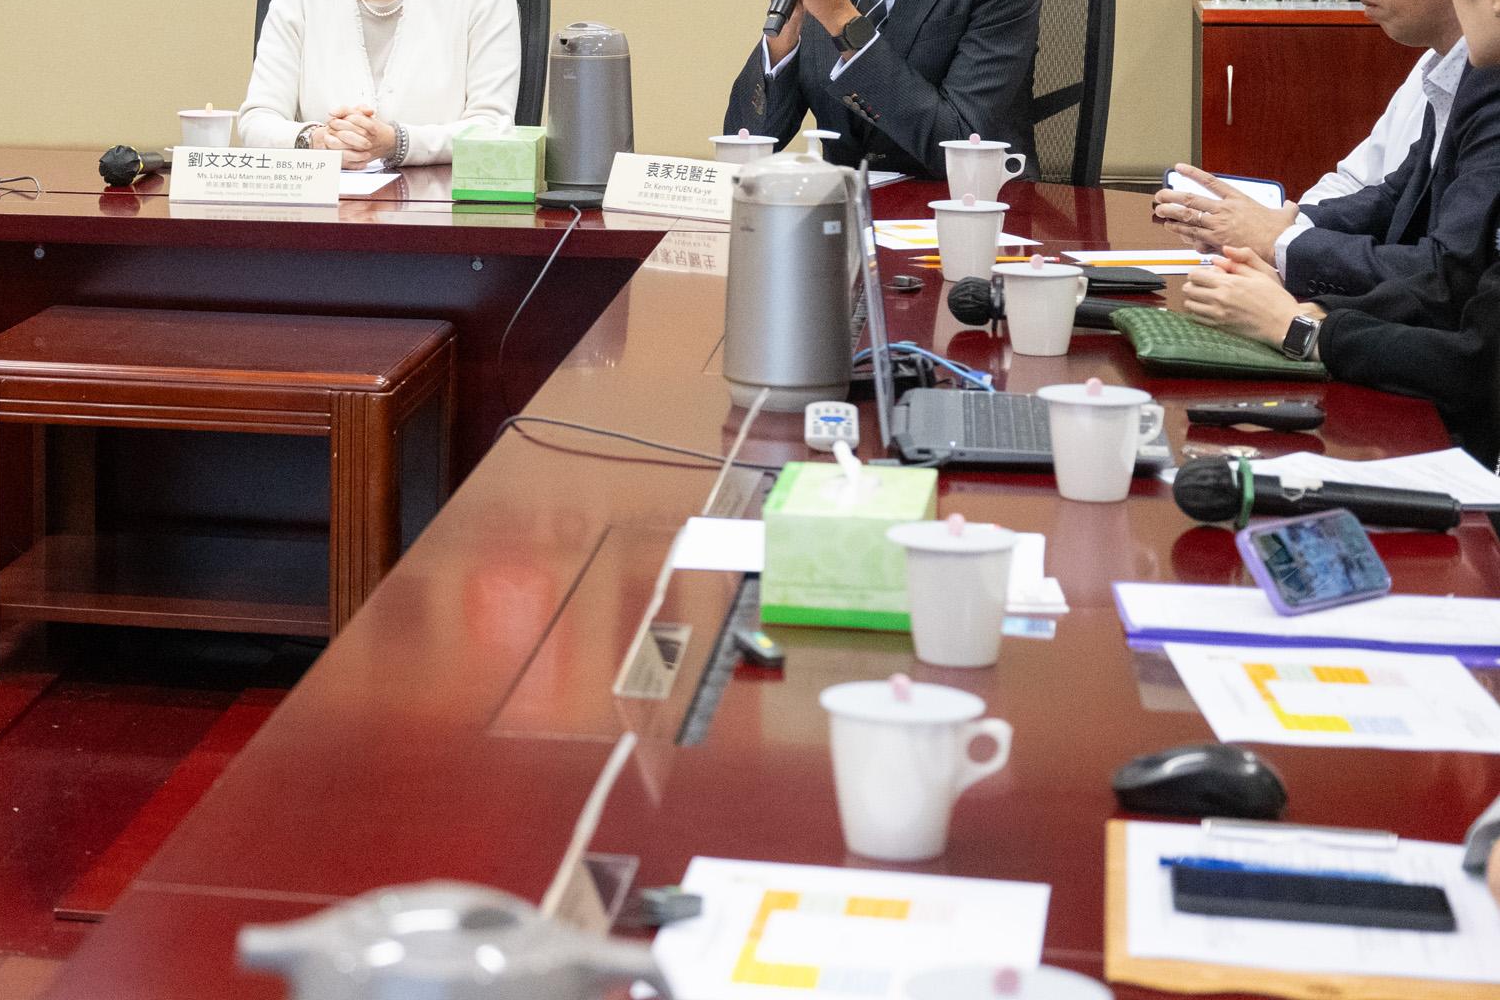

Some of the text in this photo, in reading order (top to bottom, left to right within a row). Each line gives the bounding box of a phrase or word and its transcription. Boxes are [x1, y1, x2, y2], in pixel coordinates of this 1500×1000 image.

[316, 162, 326, 170] JP
[646, 162, 718, 183] 袁家兒醫生
[654, 183, 673, 192] Kenny
[674, 185, 693, 193] YUEN
